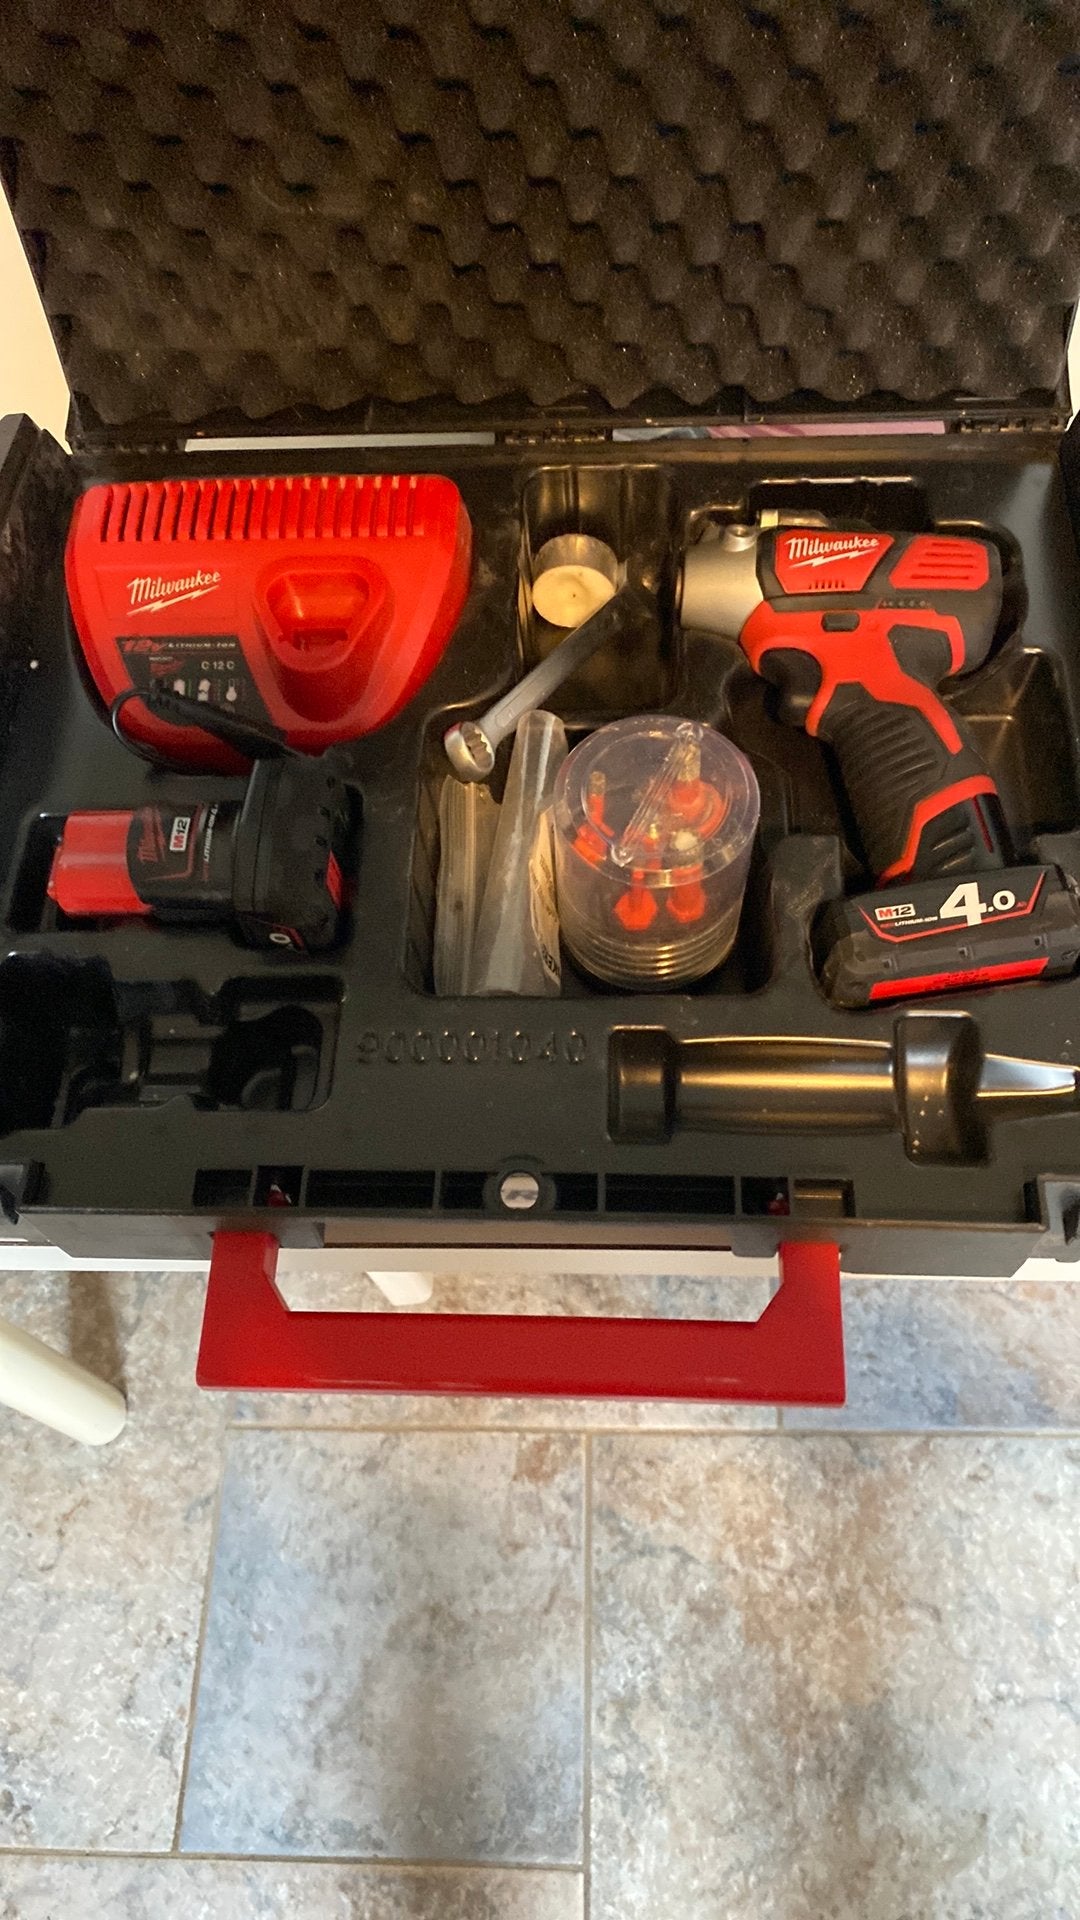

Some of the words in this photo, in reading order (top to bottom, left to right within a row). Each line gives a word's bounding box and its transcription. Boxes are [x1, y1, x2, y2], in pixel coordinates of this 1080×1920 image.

[785, 536, 880, 560] Milwaukee
[126, 569, 222, 605] Milwaukee
[173, 819, 188, 849] M12
[878, 906, 912, 919] M12
[939, 882, 1016, 927] 4.0
